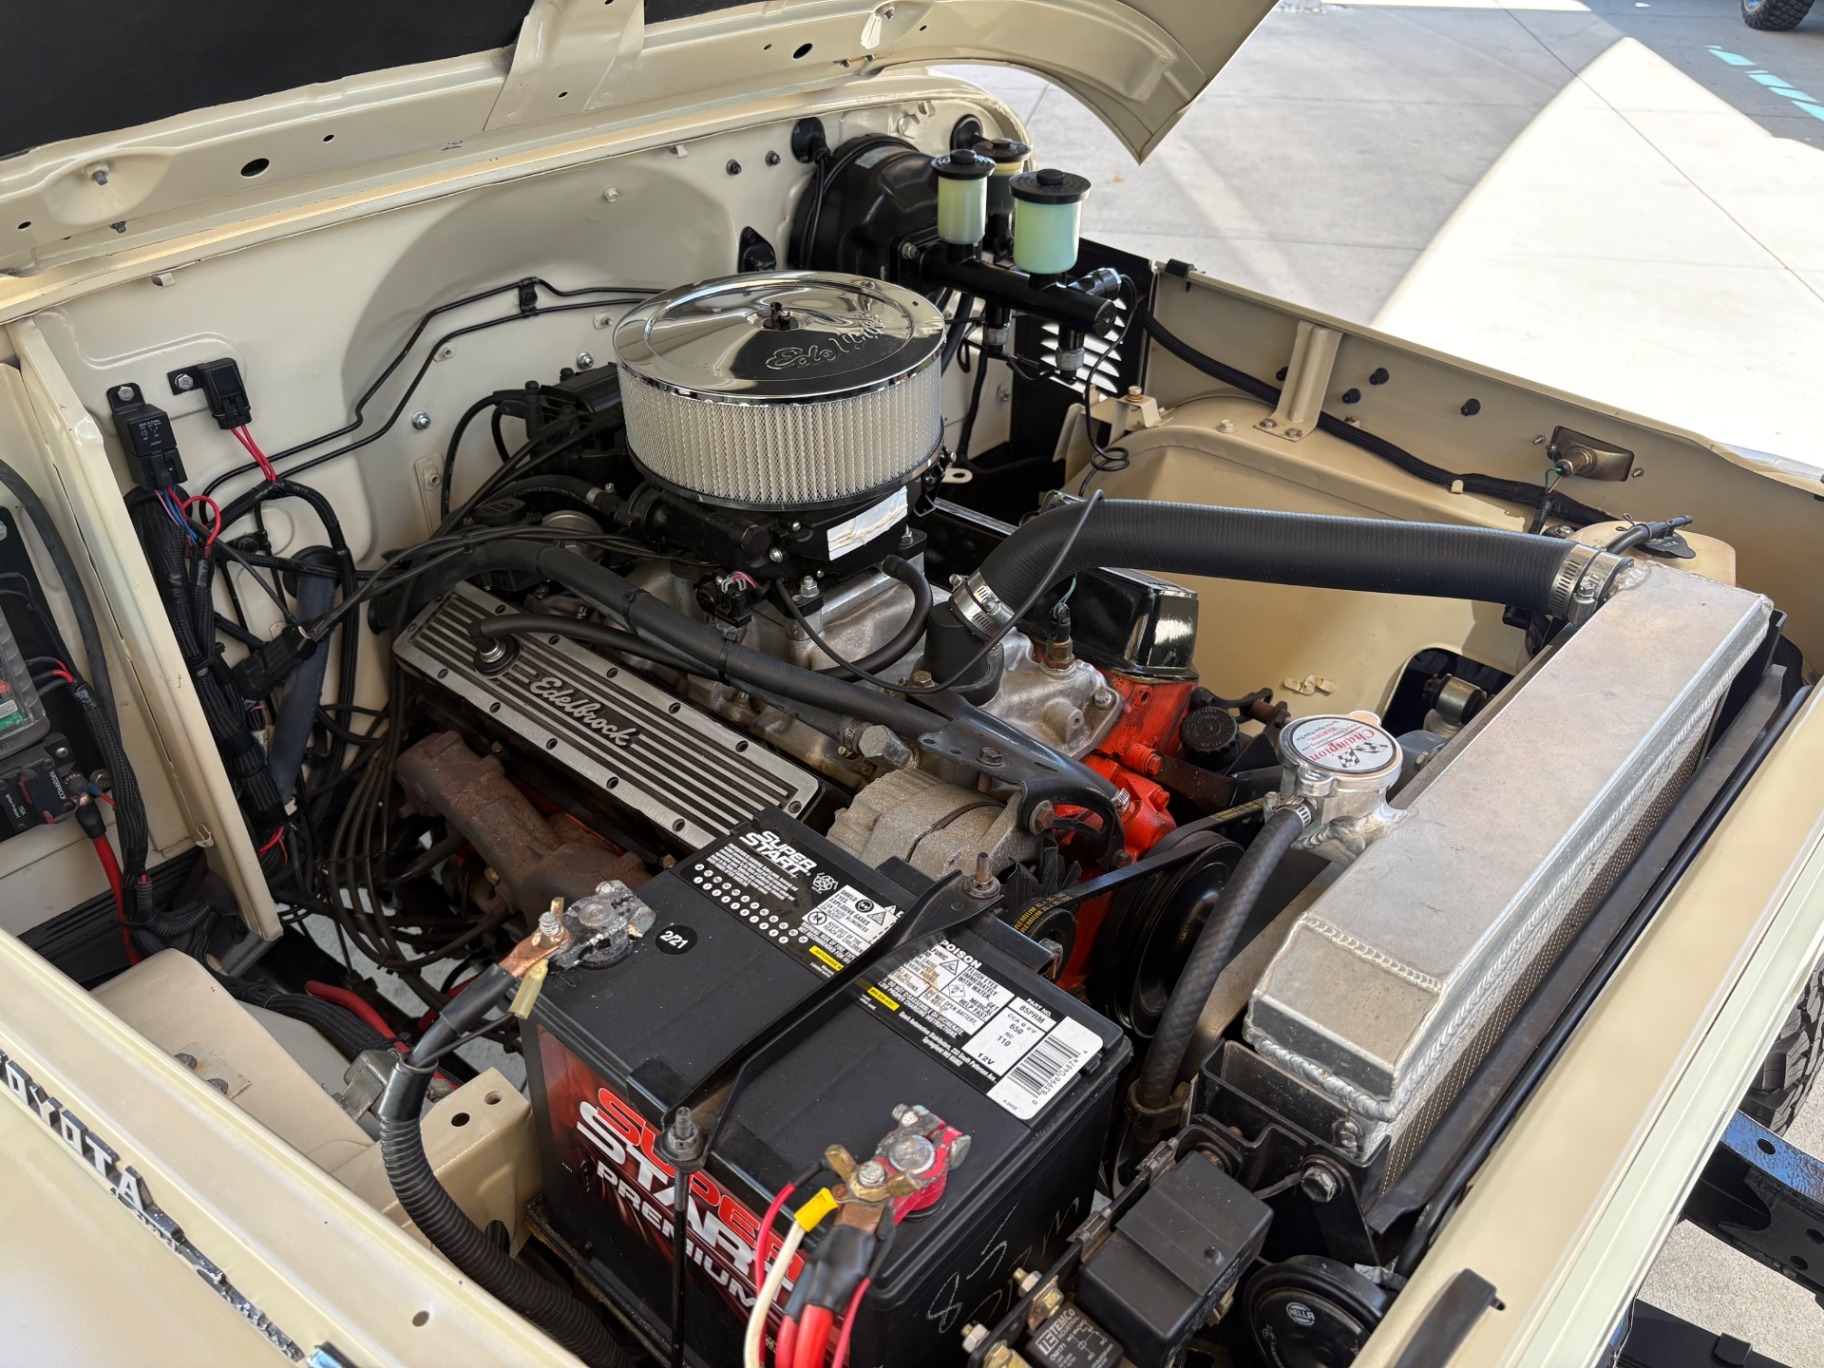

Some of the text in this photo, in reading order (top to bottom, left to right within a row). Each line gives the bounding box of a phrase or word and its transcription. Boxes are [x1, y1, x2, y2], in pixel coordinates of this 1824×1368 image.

[530, 677, 637, 745] Edelbrock
[1310, 728, 1375, 761] Champion
[739, 832, 810, 877] START
[761, 830, 817, 872] SUPER
[840, 889, 858, 902] SHIELD
[829, 897, 871, 926] EXPLOSIVE GASES
[1014, 906, 1037, 930] REMIUM
[1020, 910, 1044, 933] REMIUM
[940, 939, 982, 969] POISON
[958, 976, 974, 988] WITH
[963, 972, 998, 997] IMMEDIATELY
[967, 967, 999, 990] FLUSH EYES
[943, 1000, 957, 1011] OPEN
[958, 998, 974, 1011] HELP
[969, 998, 993, 1016] MEDICAL
[986, 1001, 1000, 1011] GET
[1019, 1004, 1046, 1024] 85PRM
[1026, 998, 1052, 1017] PART NO.
[1007, 1013, 1020, 1024] CCA
[1008, 1023, 1024, 1035] 650
[996, 1035, 1012, 1047] 110
[1004, 1032, 1014, 1040] RC
[978, 1052, 996, 1066] 12V
[0, 1049, 150, 1211] OYOTA
[597, 1087, 805, 1284] SUPER
[576, 1100, 795, 1302] START
[1049, 1308, 1076, 1334] TEMCo
[1289, 1307, 1314, 1320] HELLA
